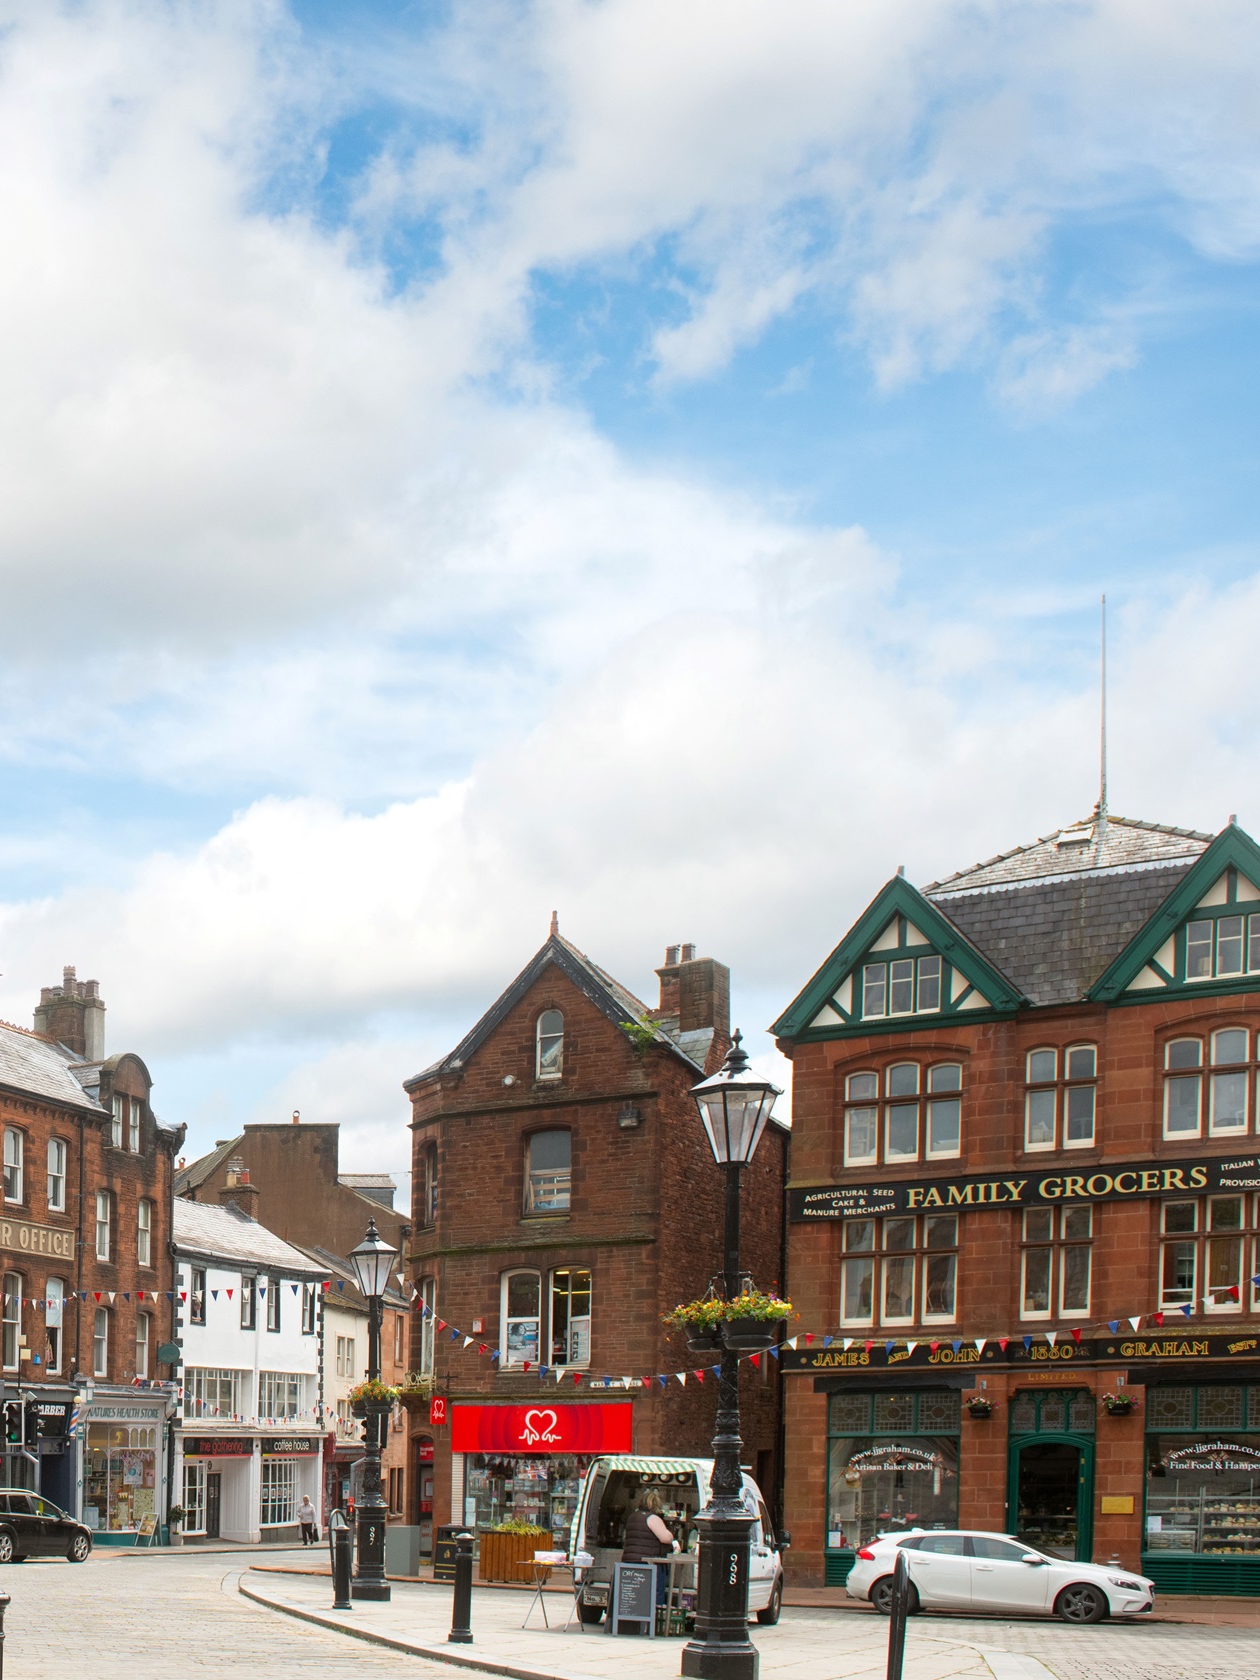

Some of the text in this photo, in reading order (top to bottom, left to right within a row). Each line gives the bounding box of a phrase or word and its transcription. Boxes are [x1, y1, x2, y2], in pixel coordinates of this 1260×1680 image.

[1220, 1160, 1255, 1171] ITALIAN
[906, 1166, 1208, 1209] FAMILY GROCERS
[804, 1188, 895, 1203] AGRICULTURAL SEED
[802, 1202, 896, 1216] MANURE MERCHANTS
[832, 1198, 866, 1207] CAKE &
[19, 1227, 69, 1255] OFFICE
[1031, 1345, 1074, 1360] 1880
[1120, 1341, 1209, 1356] GRAHAM
[812, 1348, 981, 1367] JAMES AND JOHN
[38, 1404, 66, 1416] ARBER
[87, 1407, 160, 1418] NATURES HEALTH STORE
[200, 1441, 243, 1454] the gathering
[274, 1439, 310, 1451] coffee house
[853, 1462, 933, 1471] Artisan Baker & Deli
[1170, 1461, 1188, 1470] Fine
[1191, 1461, 1214, 1470] Food
[1215, 1461, 1223, 1470] &
[729, 1553, 738, 1585] 998
